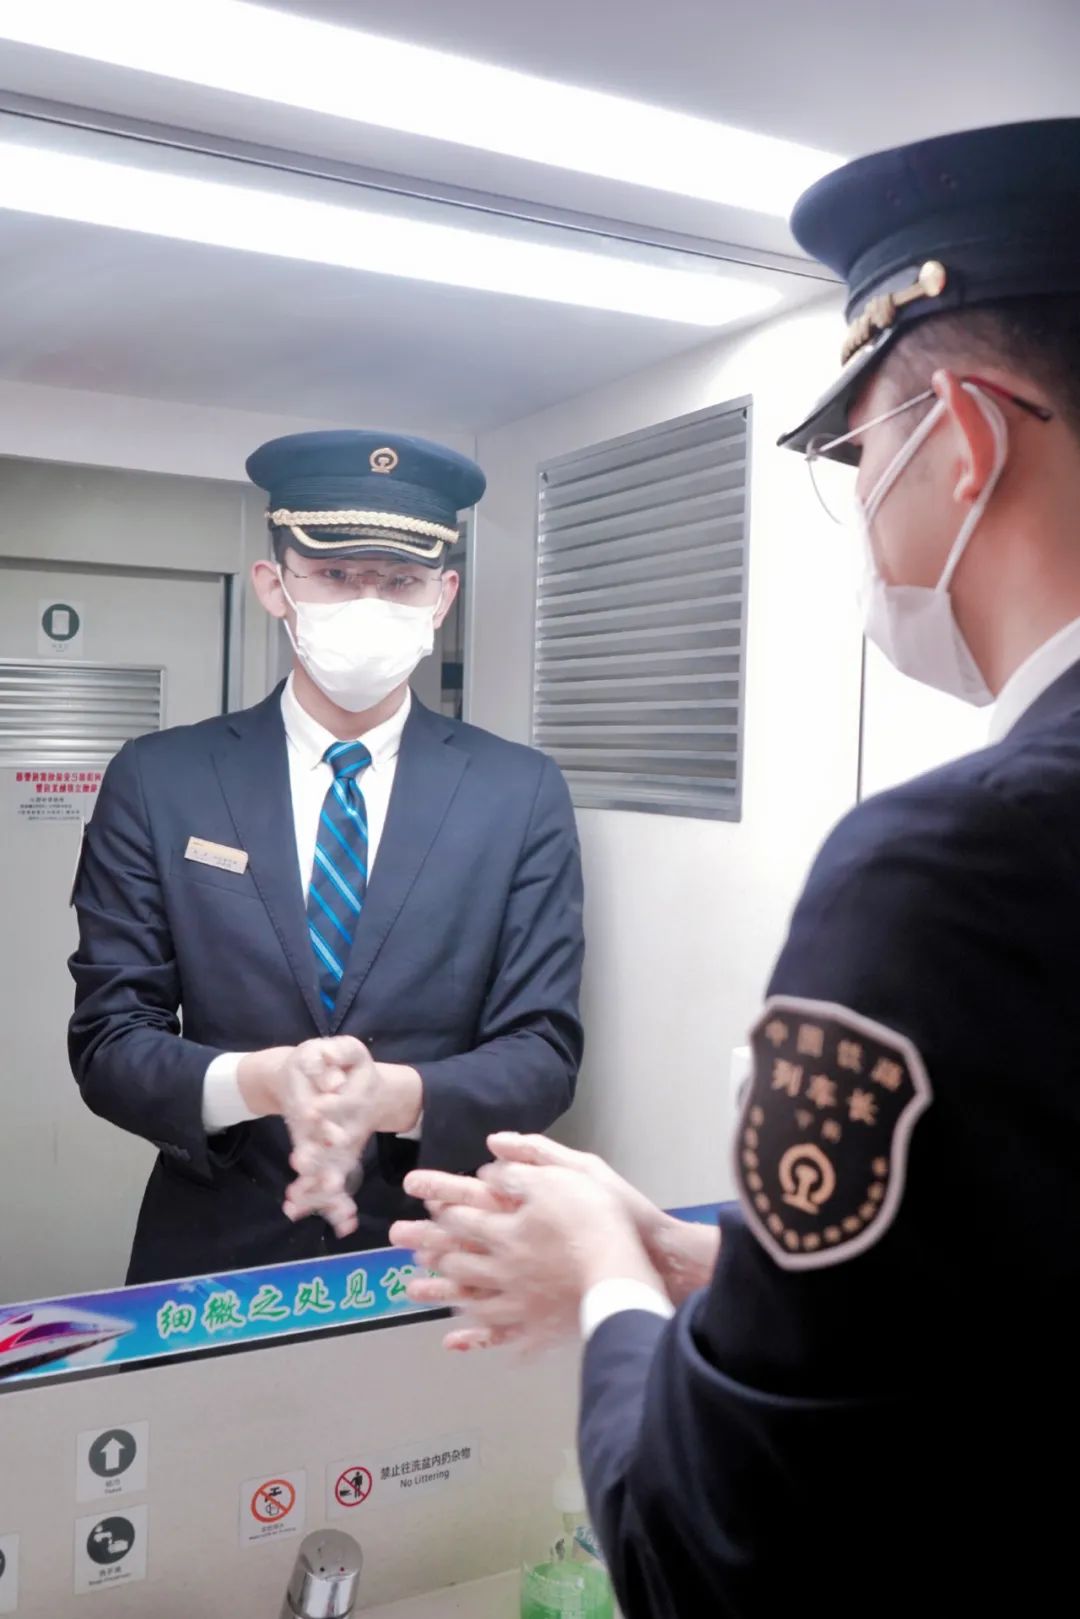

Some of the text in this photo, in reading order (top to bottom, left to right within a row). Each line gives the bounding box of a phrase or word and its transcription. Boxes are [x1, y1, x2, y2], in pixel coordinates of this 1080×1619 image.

[158, 1262, 441, 1337] 细微之处见公
[380, 1447, 471, 1480] 禁止往洗盆内扔杂物
[399, 1469, 450, 1488] No Littering
